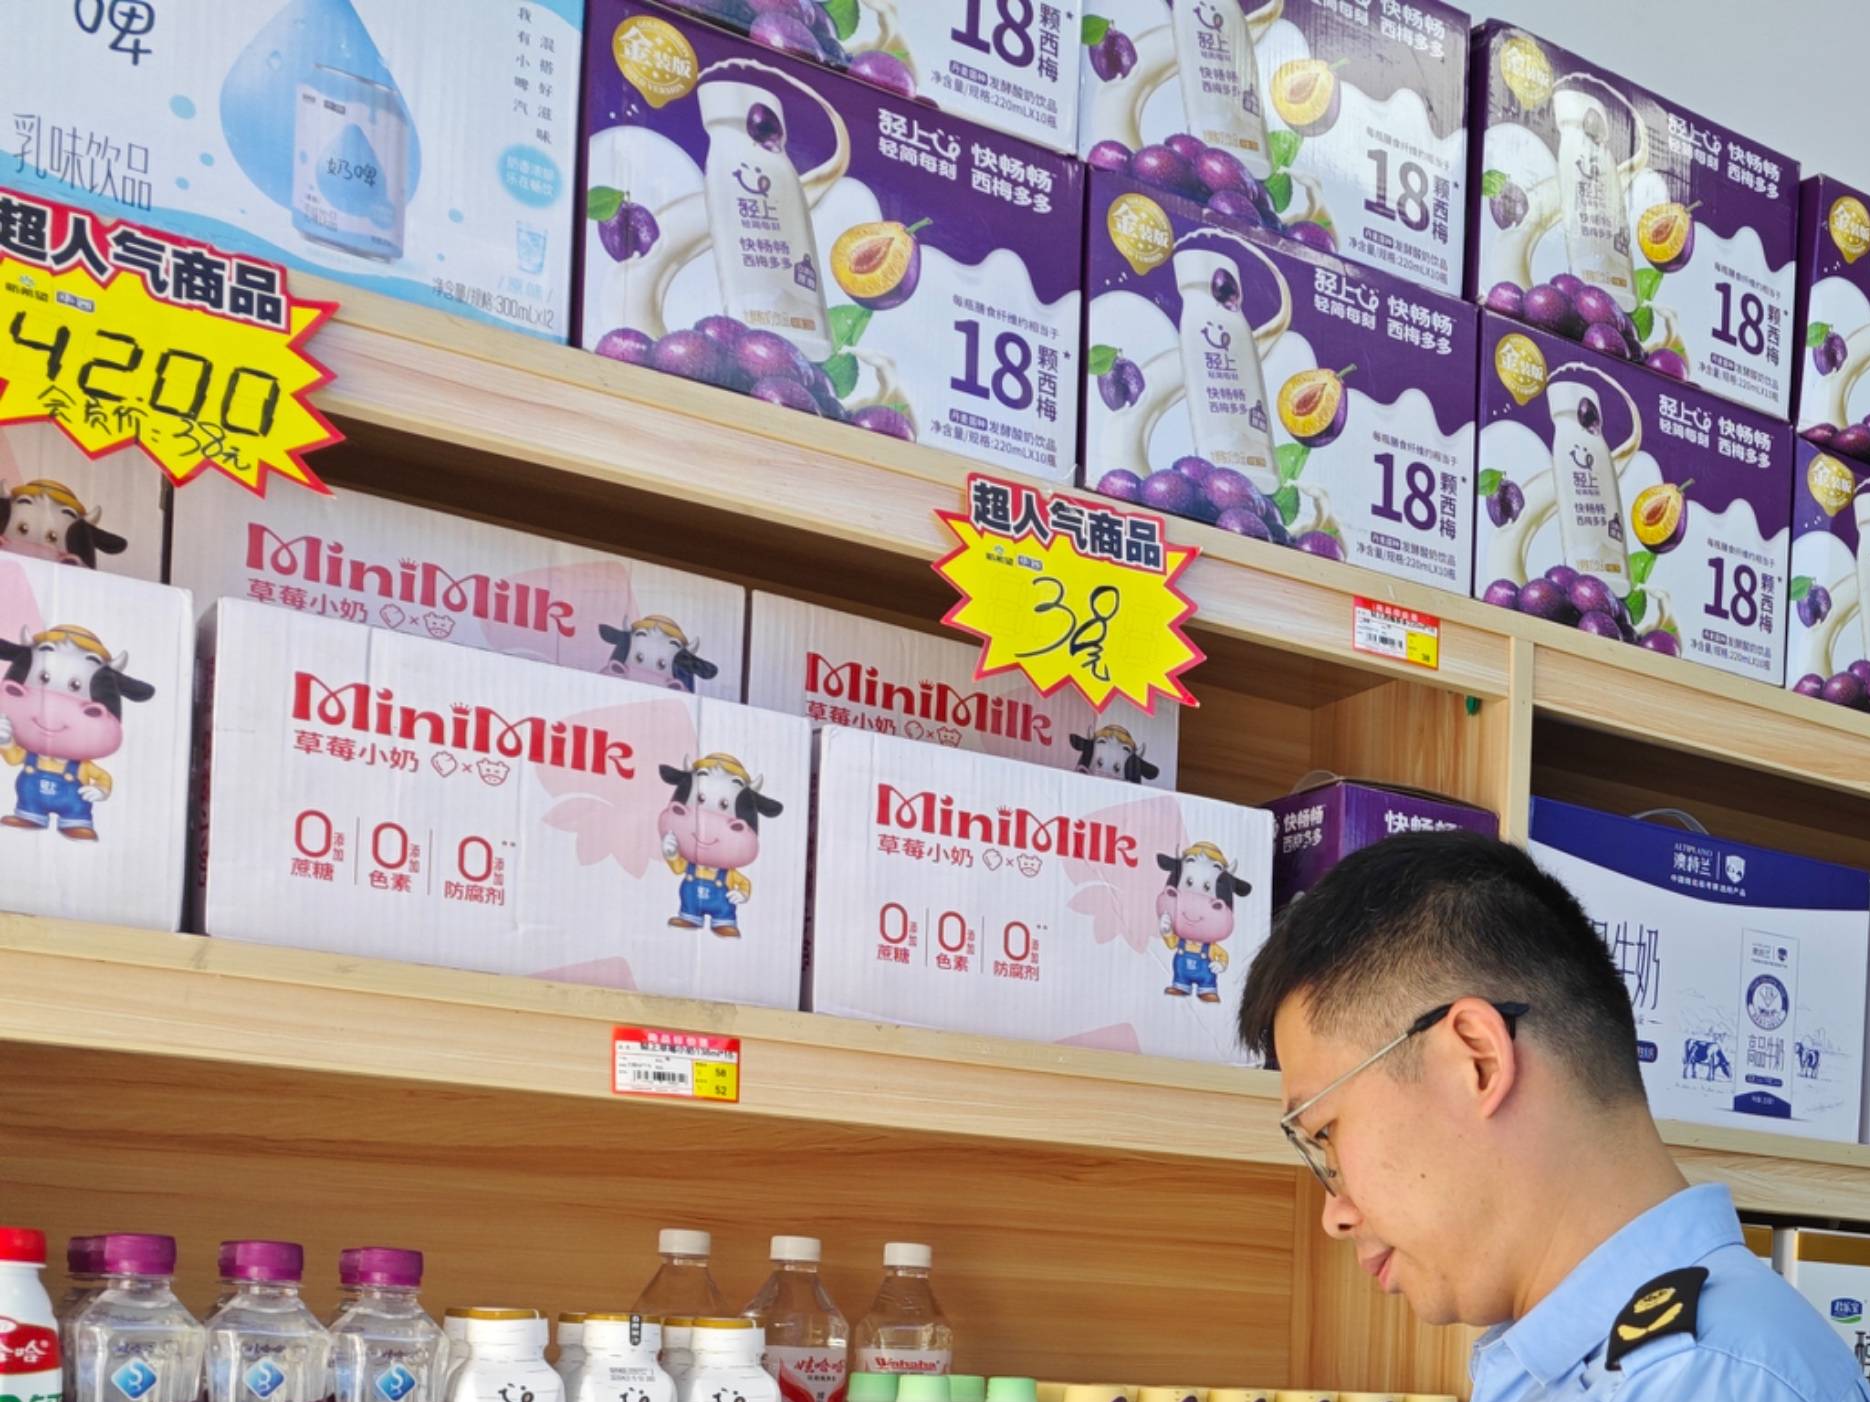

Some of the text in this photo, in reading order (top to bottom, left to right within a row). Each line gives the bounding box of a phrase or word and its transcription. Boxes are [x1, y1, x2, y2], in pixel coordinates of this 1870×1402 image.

[12, 112, 153, 213] 乳味饮品
[972, 143, 1054, 194] 快畅畅
[971, 170, 1052, 213] 西梅多多
[1365, 150, 1429, 231] 18
[0, 198, 283, 325] 超人气商品
[953, 294, 1060, 340] 每瓶膳食纤维约相当于
[1388, 295, 1452, 335] 快畅畅
[1388, 318, 1452, 354] 西梅多多
[1712, 282, 1764, 356] 18
[1037, 344, 1059, 422] 颗西梅
[1718, 416, 1772, 451] 快畅畅
[973, 481, 1161, 568] 超人气商品
[246, 522, 577, 638] MiniMilk
[1704, 556, 1757, 627] 18
[805, 651, 1053, 747] MiniMilk
[291, 671, 635, 779] MiniMilk
[294, 730, 419, 774] 草莓小奶
[294, 809, 334, 858] 0
[372, 822, 408, 869] 0
[875, 783, 1139, 868] MiniMilk
[290, 856, 335, 882] 蔗糖
[877, 833, 974, 871] 草莓小奶
[369, 869, 413, 894] 色素
[444, 880, 506, 907] 防腐剂
[876, 945, 911, 966] 蔗糖
[936, 952, 969, 973] 色素
[1002, 920, 1031, 961] 0
[992, 960, 1041, 982] 防腐剂
